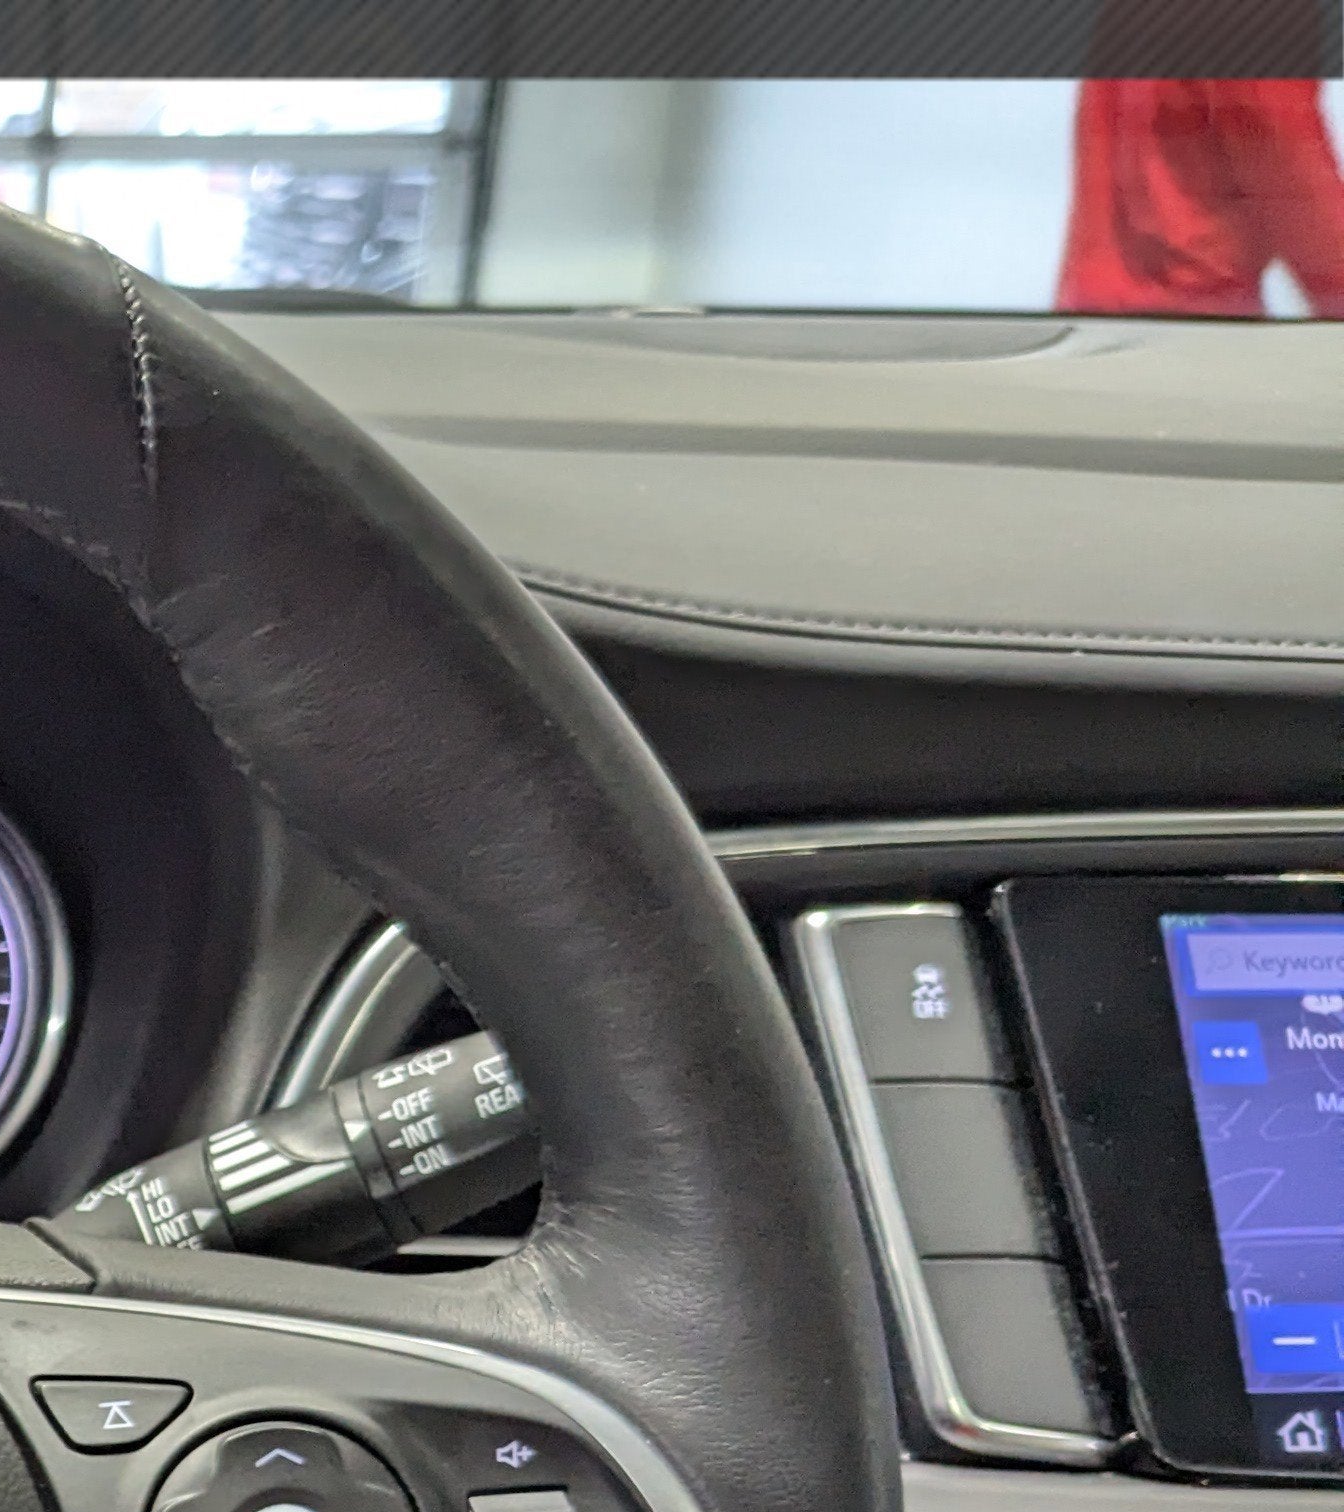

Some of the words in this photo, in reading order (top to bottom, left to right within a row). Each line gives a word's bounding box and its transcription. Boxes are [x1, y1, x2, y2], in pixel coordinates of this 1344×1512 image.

[391, 1087, 433, 1121] OFF
[400, 1114, 439, 1149] INT
[413, 1144, 452, 1175] ON
[141, 1177, 164, 1201] HI
[146, 1196, 174, 1223] LO
[154, 1212, 189, 1247] INT
